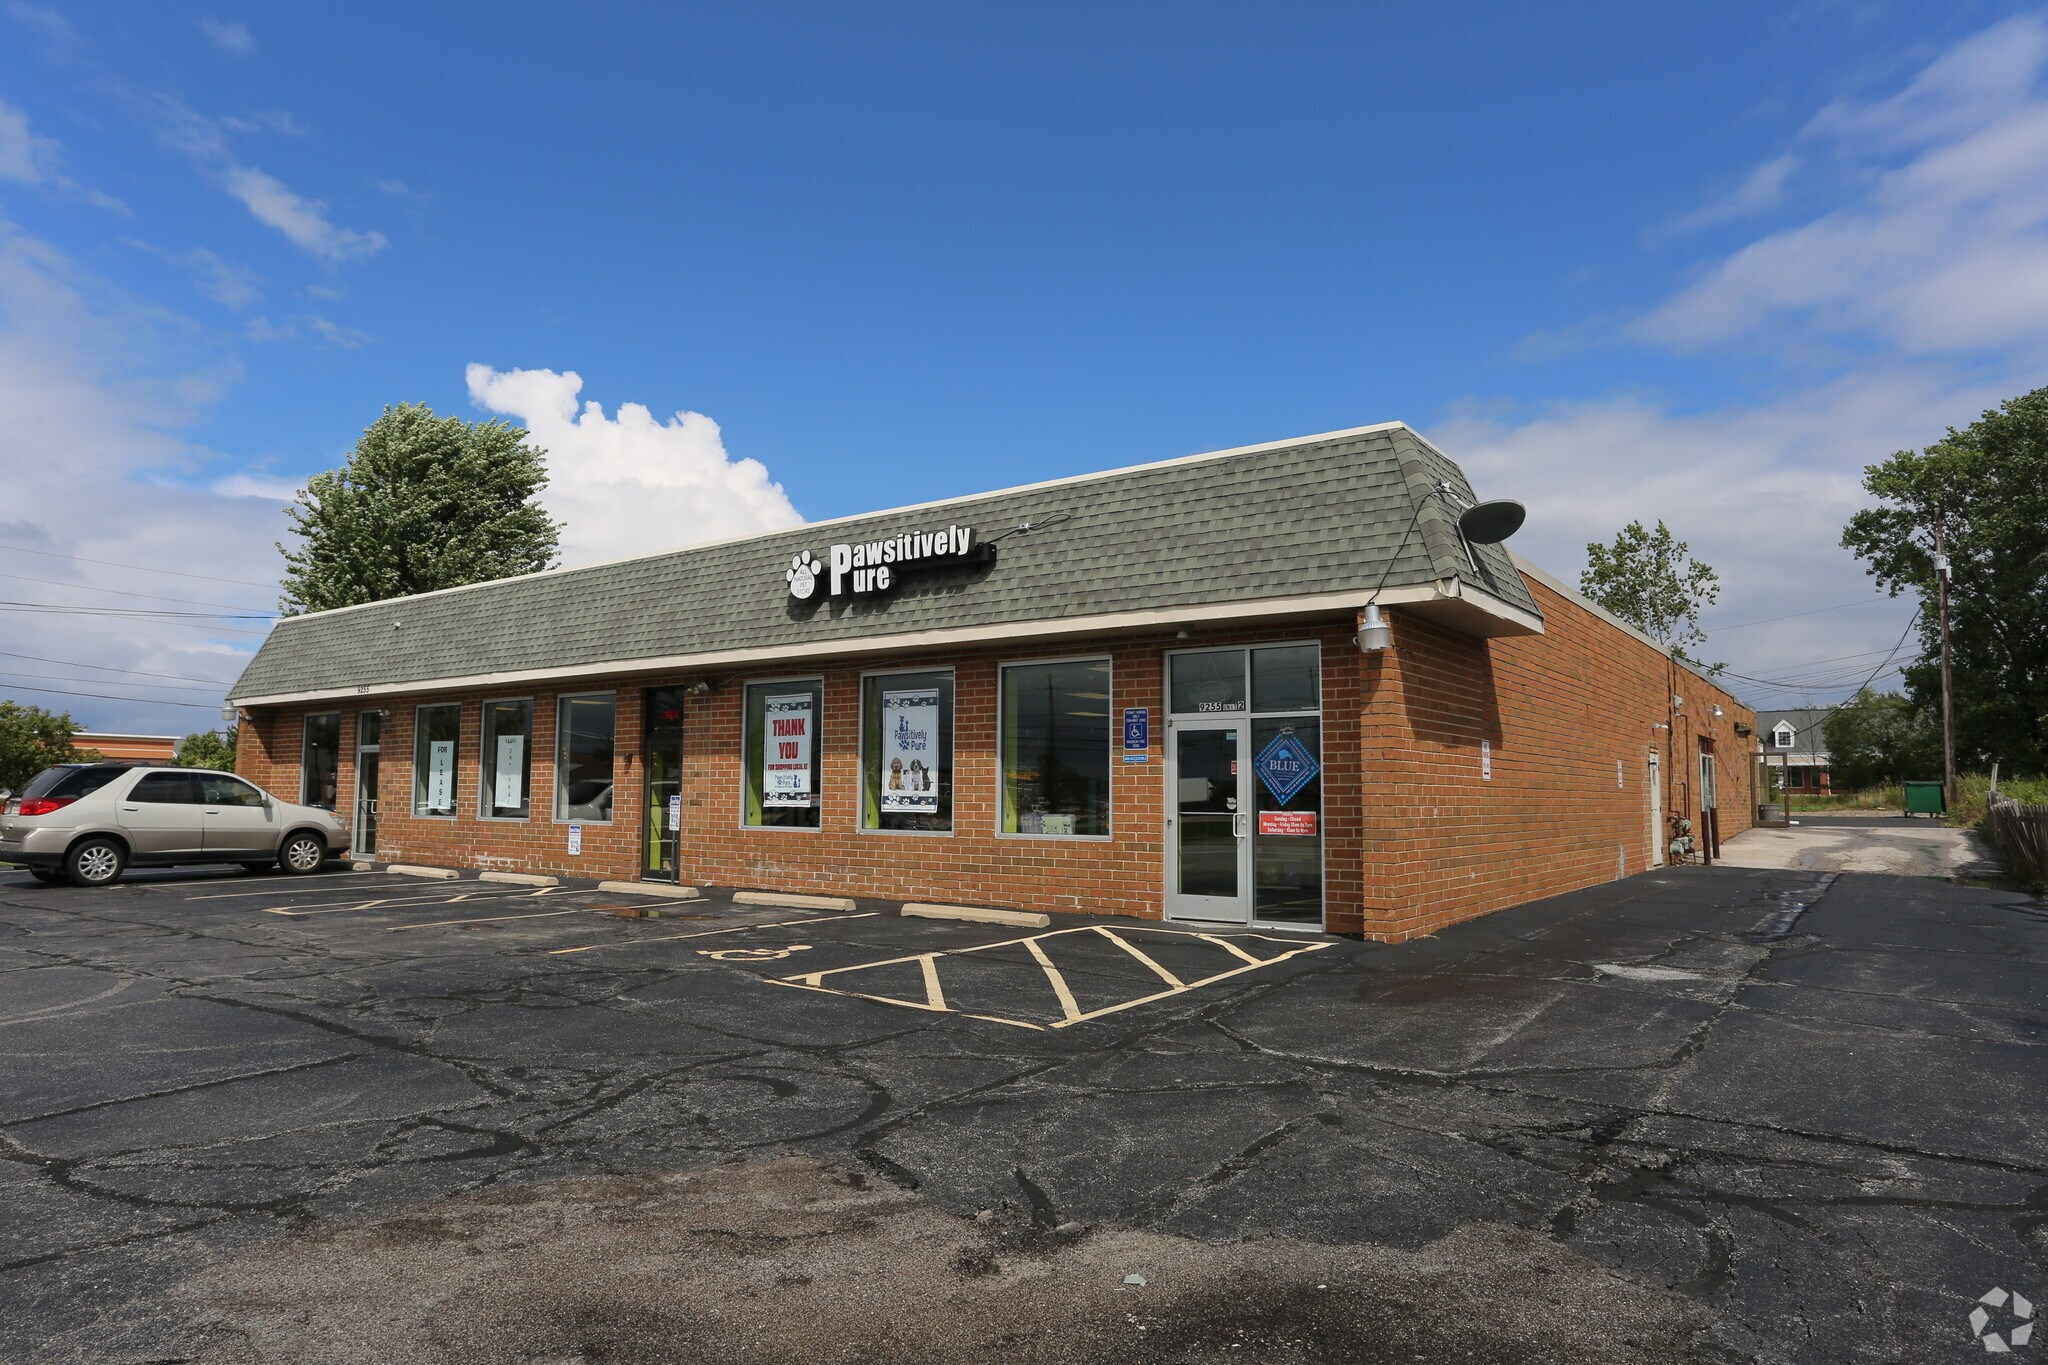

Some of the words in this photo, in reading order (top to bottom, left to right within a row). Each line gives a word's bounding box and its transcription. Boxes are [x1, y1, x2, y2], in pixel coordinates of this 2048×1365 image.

[830, 525, 971, 596] Pawsitively
[357, 684, 370, 694] 9255
[1200, 703, 1221, 711] 9255
[772, 718, 806, 736] THANK
[895, 730, 927, 742] Pawsitively
[779, 742, 798, 759] YOU
[911, 741, 926, 750] Pure
[1270, 760, 1300, 771] BLUE
